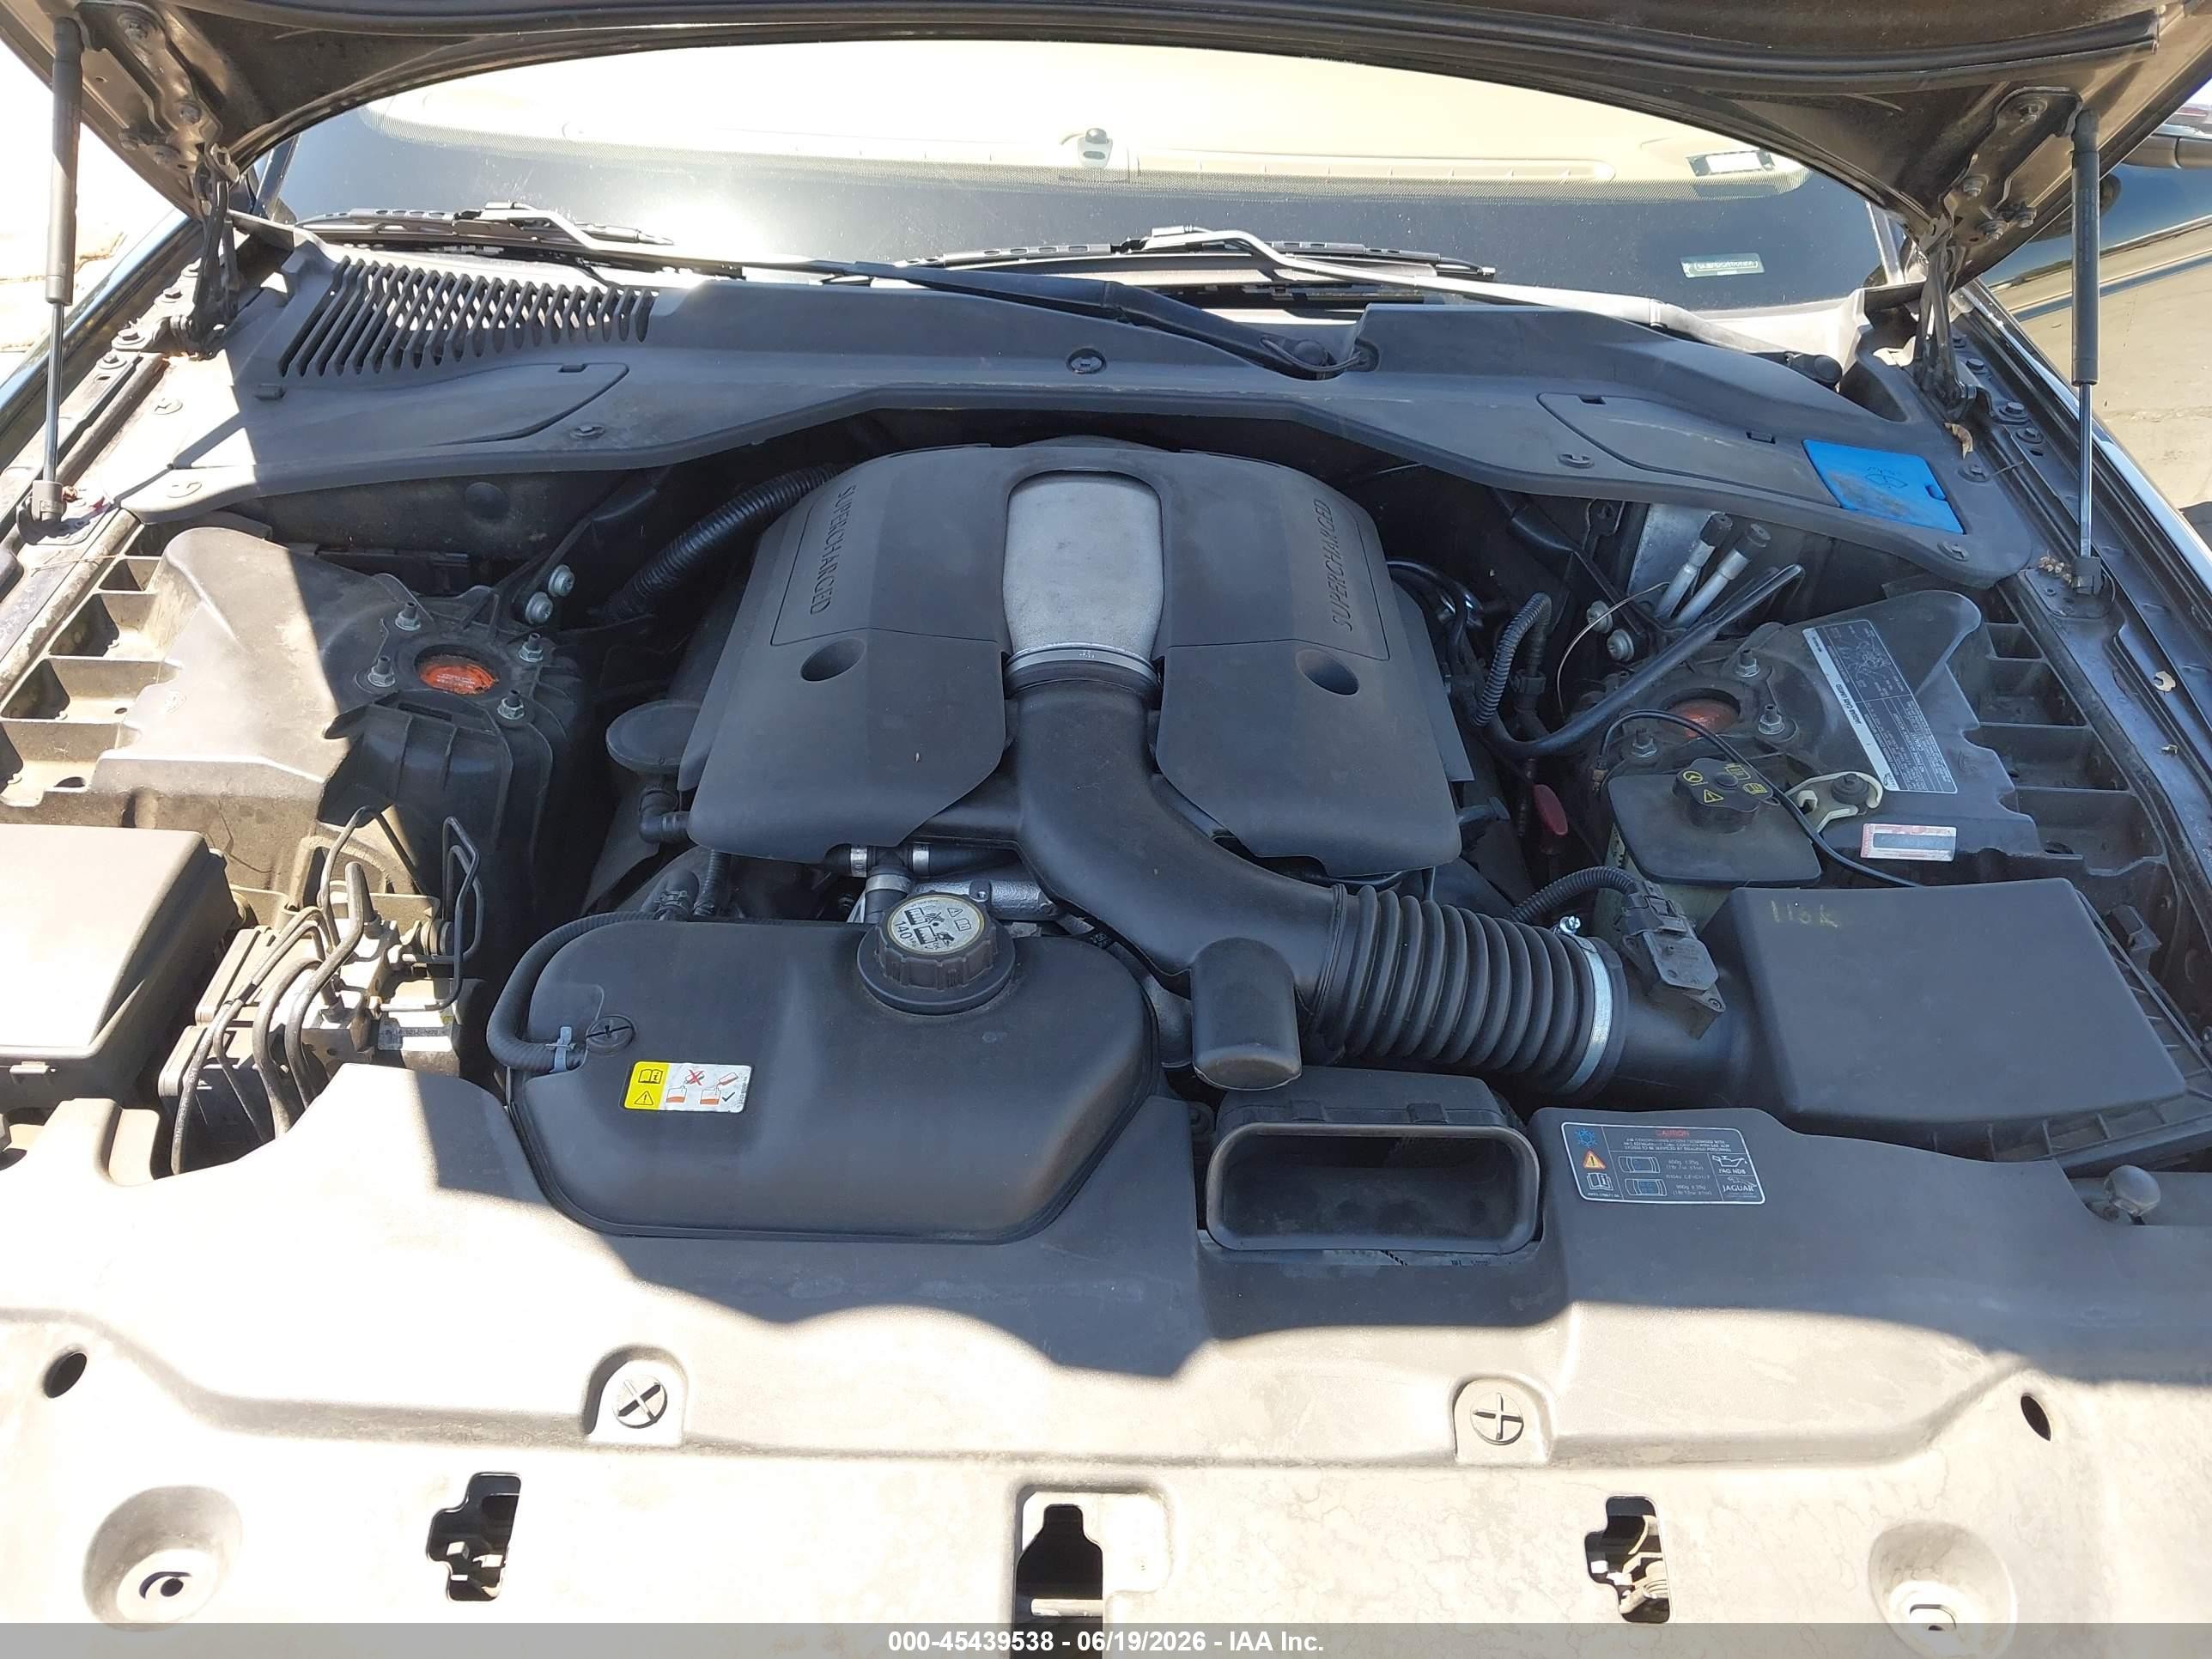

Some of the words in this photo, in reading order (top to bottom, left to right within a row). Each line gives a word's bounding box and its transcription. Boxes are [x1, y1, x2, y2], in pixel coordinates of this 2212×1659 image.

[810, 484, 857, 616] SUPERCHARGED
[1313, 499, 1353, 633] SUPERCHARGED
[895, 921, 913, 939] 140
[1722, 1184, 1755, 1193] JAGUAR
